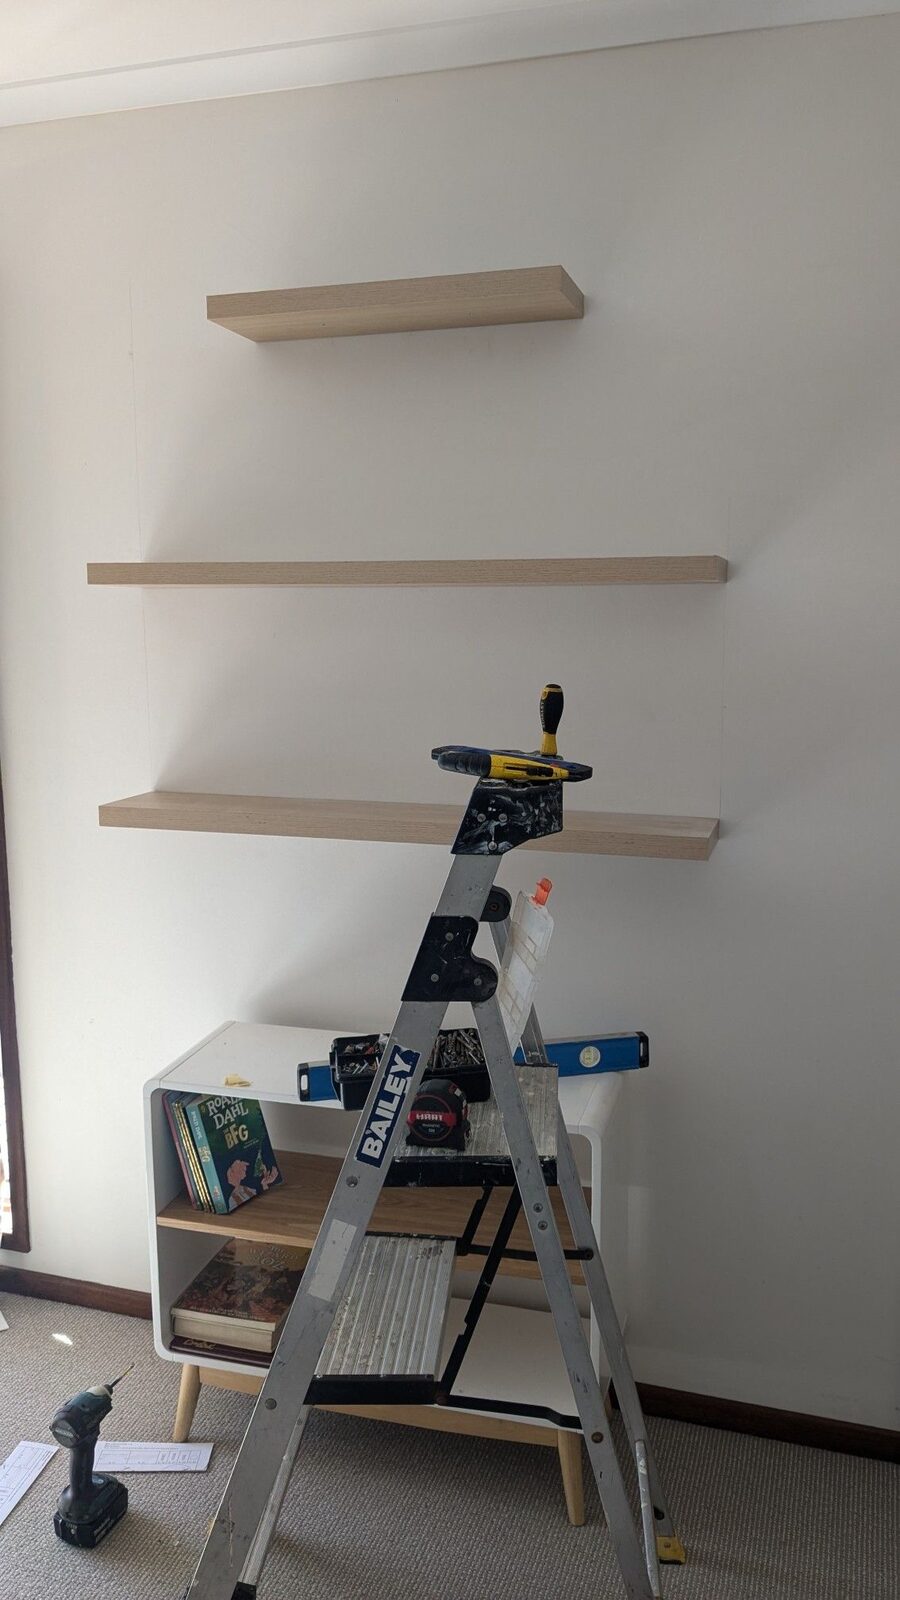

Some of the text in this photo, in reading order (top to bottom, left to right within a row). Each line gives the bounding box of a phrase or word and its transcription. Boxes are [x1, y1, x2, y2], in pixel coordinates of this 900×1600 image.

[213, 1103, 249, 1129] DAHL
[361, 1052, 411, 1159] BAILEY
[416, 1113, 443, 1121] HART
[224, 1124, 249, 1149] BFG
